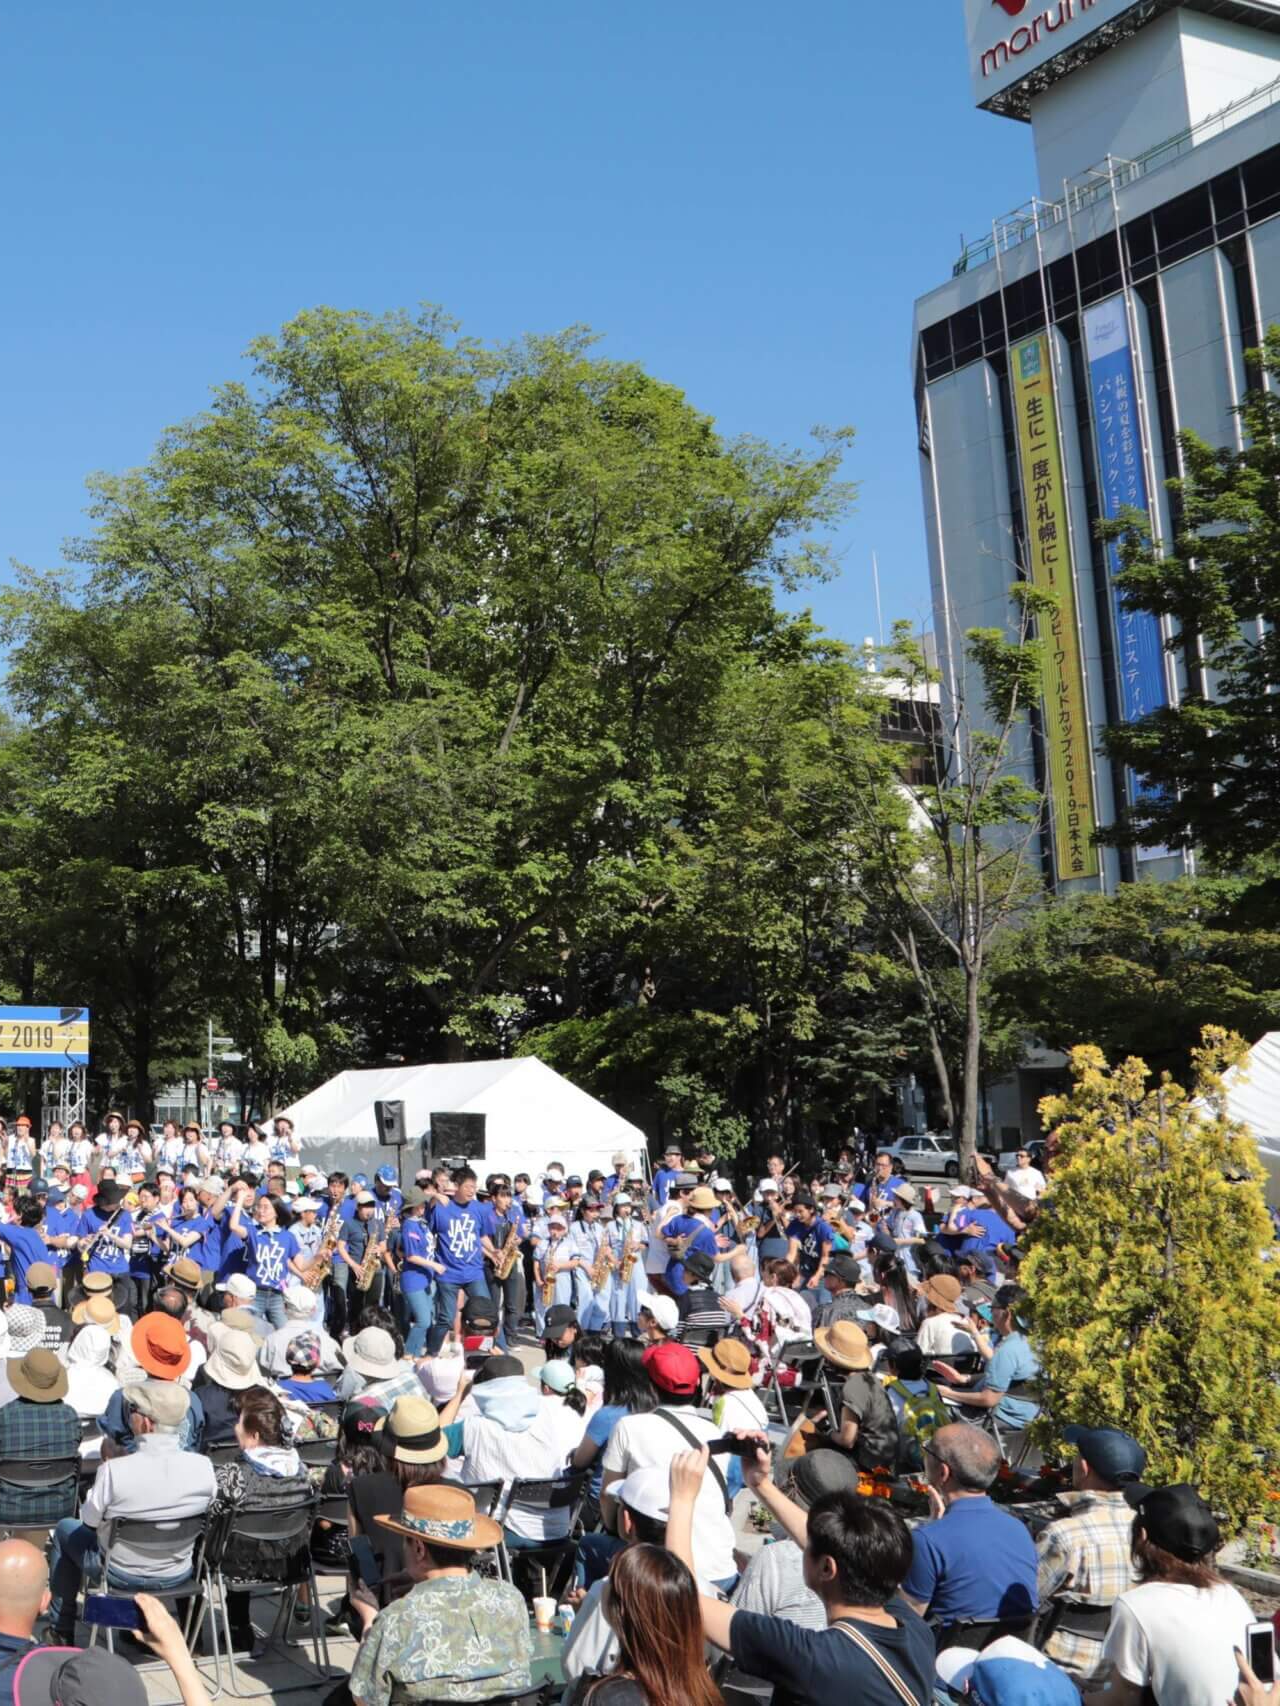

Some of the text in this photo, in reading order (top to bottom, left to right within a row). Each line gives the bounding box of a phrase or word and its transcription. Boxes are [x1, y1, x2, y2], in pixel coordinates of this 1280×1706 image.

[1049, 606, 1086, 872] グビーワールドカップ2019日本大会
[11, 1025, 54, 1049] 2019
[447, 1213, 476, 1241] JAZZ
[256, 1241, 286, 1264] JAZZ
